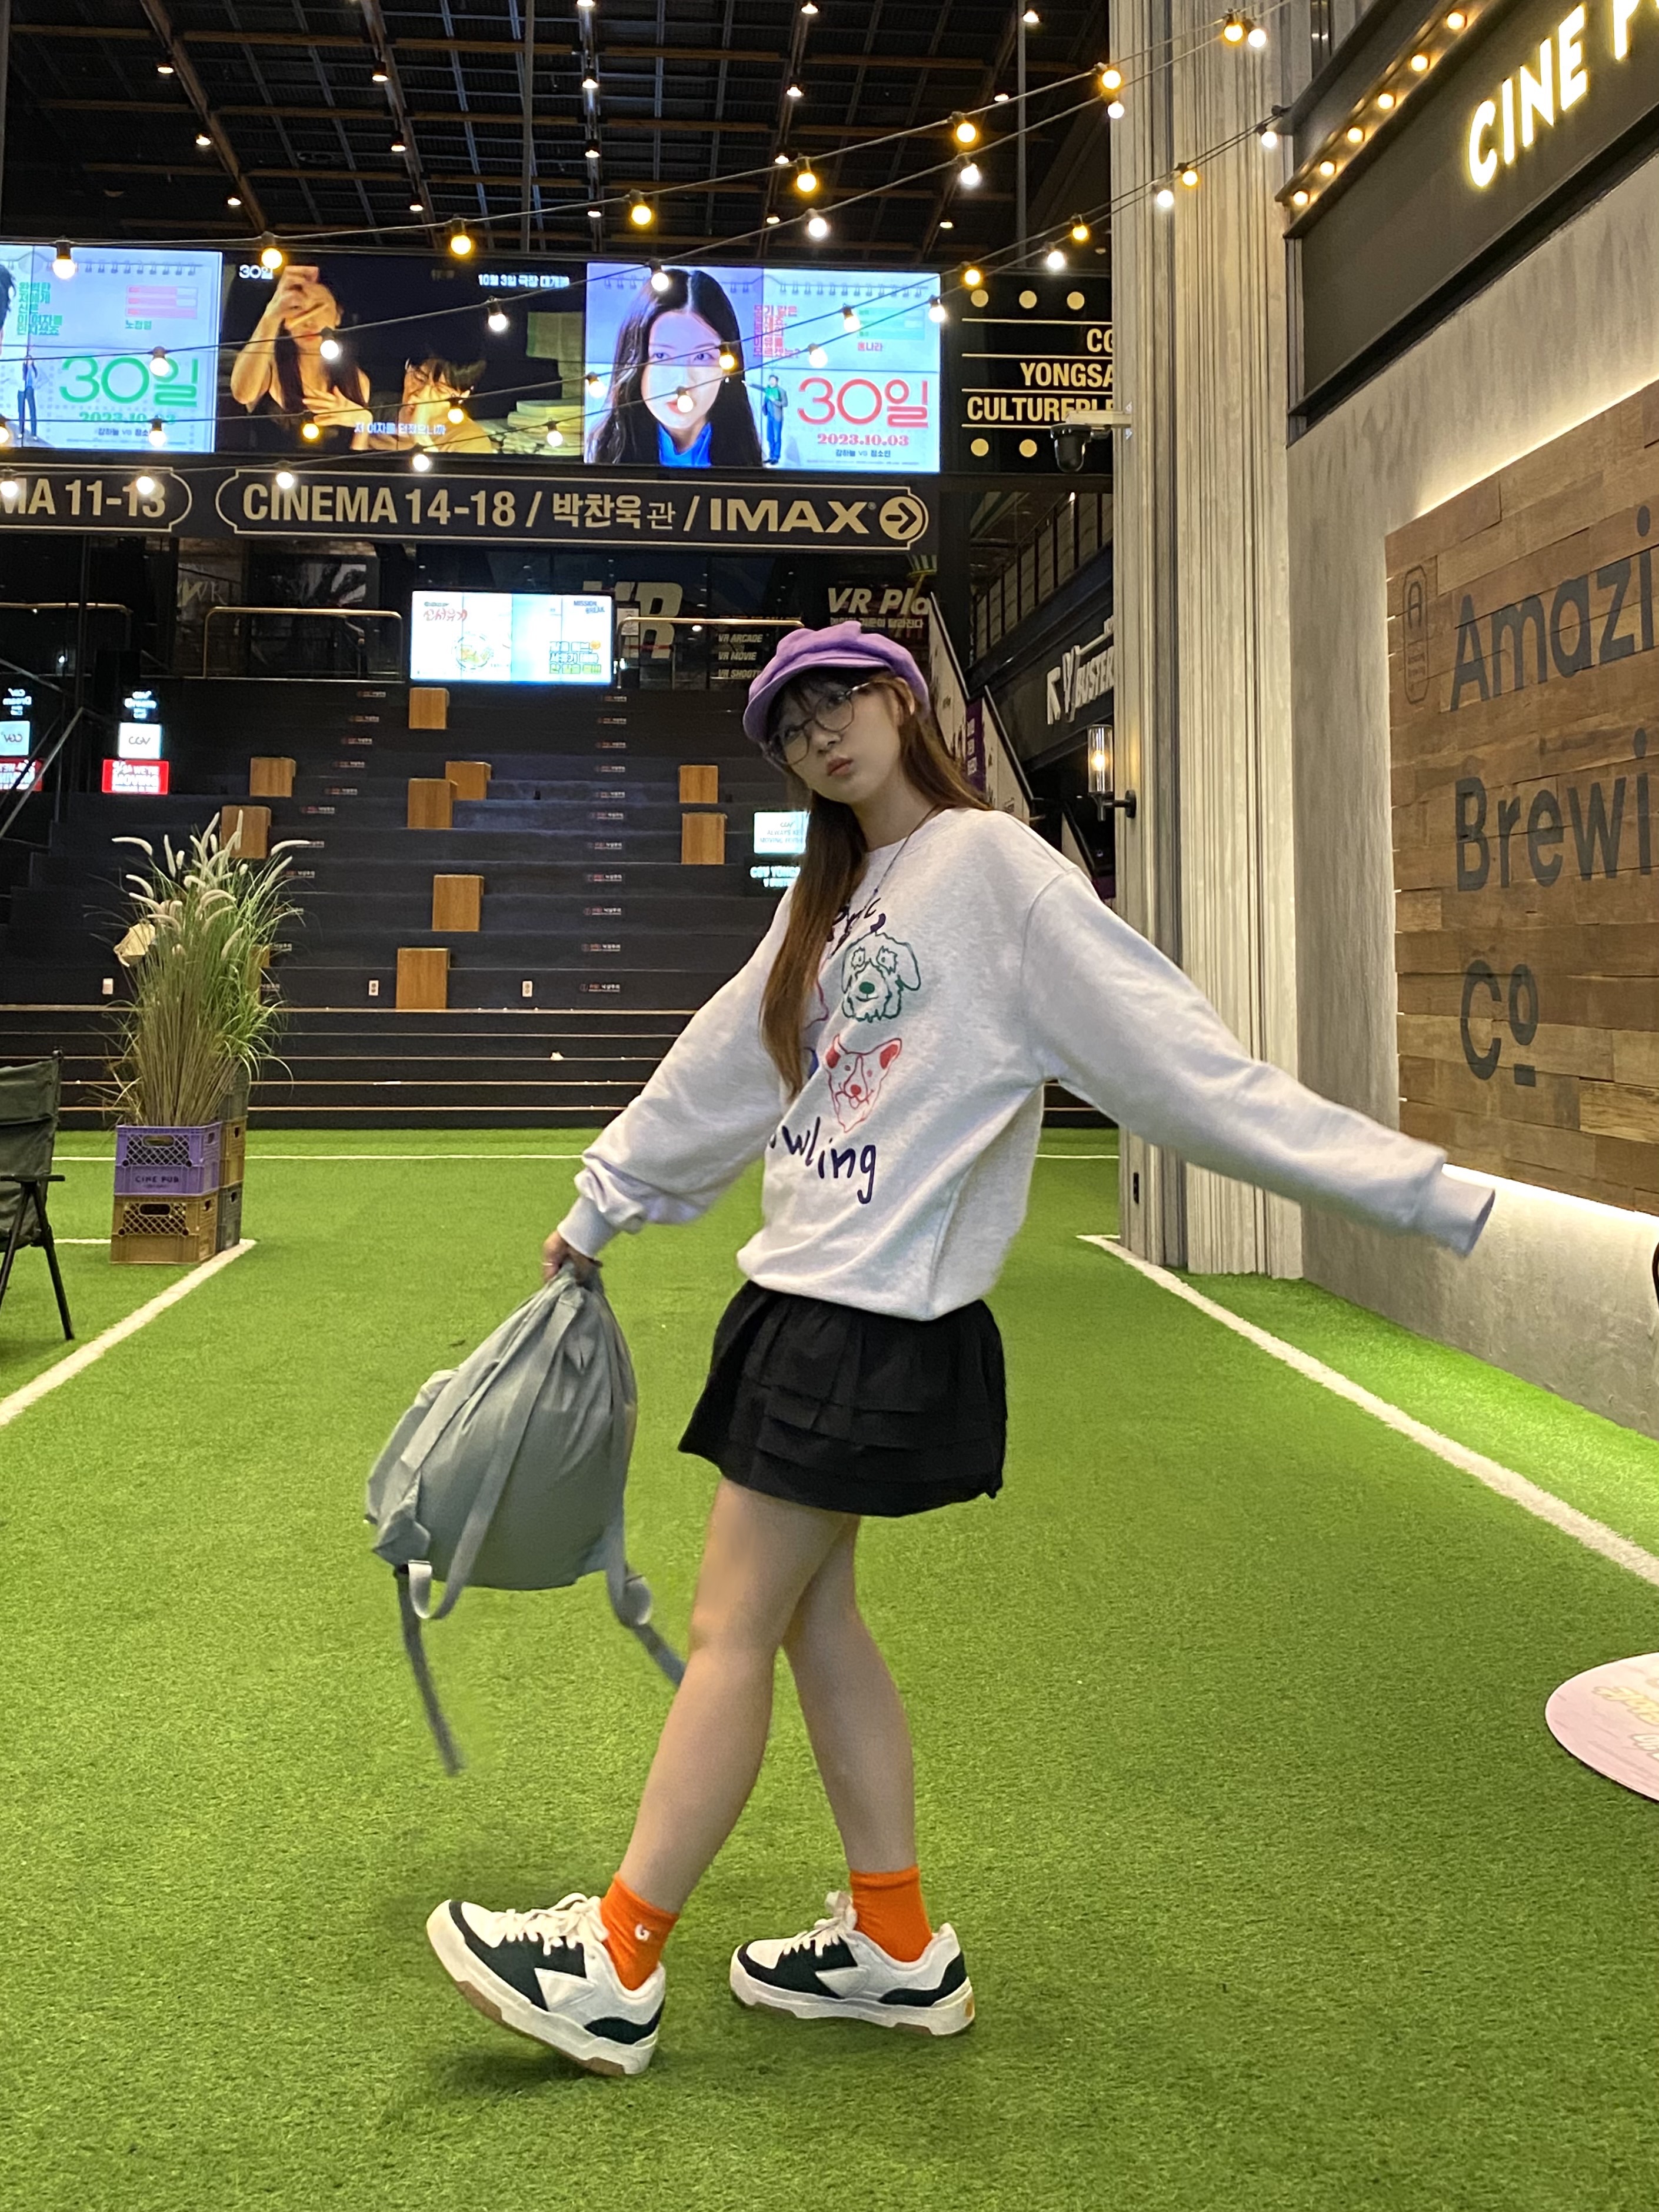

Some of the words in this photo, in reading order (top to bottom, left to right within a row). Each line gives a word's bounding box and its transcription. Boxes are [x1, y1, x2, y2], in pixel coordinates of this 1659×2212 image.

[1468, 4, 1589, 188] CINE
[1612, 0, 1659, 60] P
[239, 265, 273, 279] 30일
[499, 274, 517, 287] 3일
[518, 274, 538, 288] 극장
[32, 315, 63, 327] 여자
[754, 336, 783, 347] 이유
[858, 342, 882, 352] 나라
[59, 356, 198, 408] 30일
[1020, 362, 1112, 388] YONGSA
[798, 377, 928, 428] 30일
[817, 434, 910, 446] 2023.10.03
[65, 479, 166, 518] 11-13
[243, 483, 398, 524] CINEMA
[405, 489, 516, 526] 14-18
[525, 490, 542, 528] /
[553, 492, 641, 529] 박찬욱
[647, 501, 676, 530] 관
[683, 495, 701, 531] /
[709, 497, 871, 534] IMAX
[827, 587, 872, 614] VR
[879, 588, 930, 615] Pla
[1450, 505, 1654, 712] Amazi
[729, 634, 764, 644] ARCADE
[730, 651, 757, 661] MOVIE
[128, 736, 151, 745] CGV
[1455, 727, 1652, 892] Brewi
[769, 1116, 877, 1205] wling
